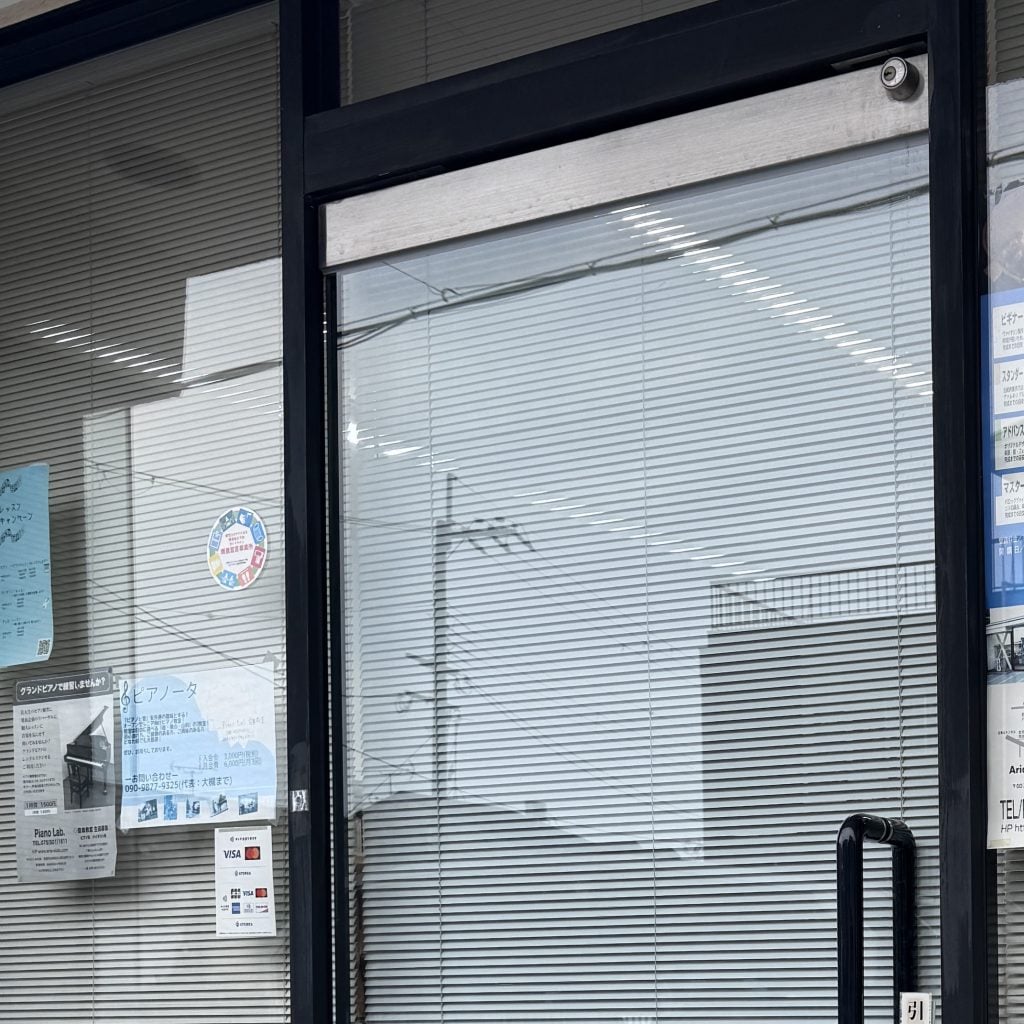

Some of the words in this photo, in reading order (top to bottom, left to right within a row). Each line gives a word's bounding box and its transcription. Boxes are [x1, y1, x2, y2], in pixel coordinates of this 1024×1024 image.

[133, 681, 198, 704] ピアノータ
[34, 828, 51, 838] Piano
[53, 828, 65, 837] Lab.
[1000, 824, 1013, 833] HP
[224, 850, 241, 858] VISA
[908, 1001, 923, 1021] 引
